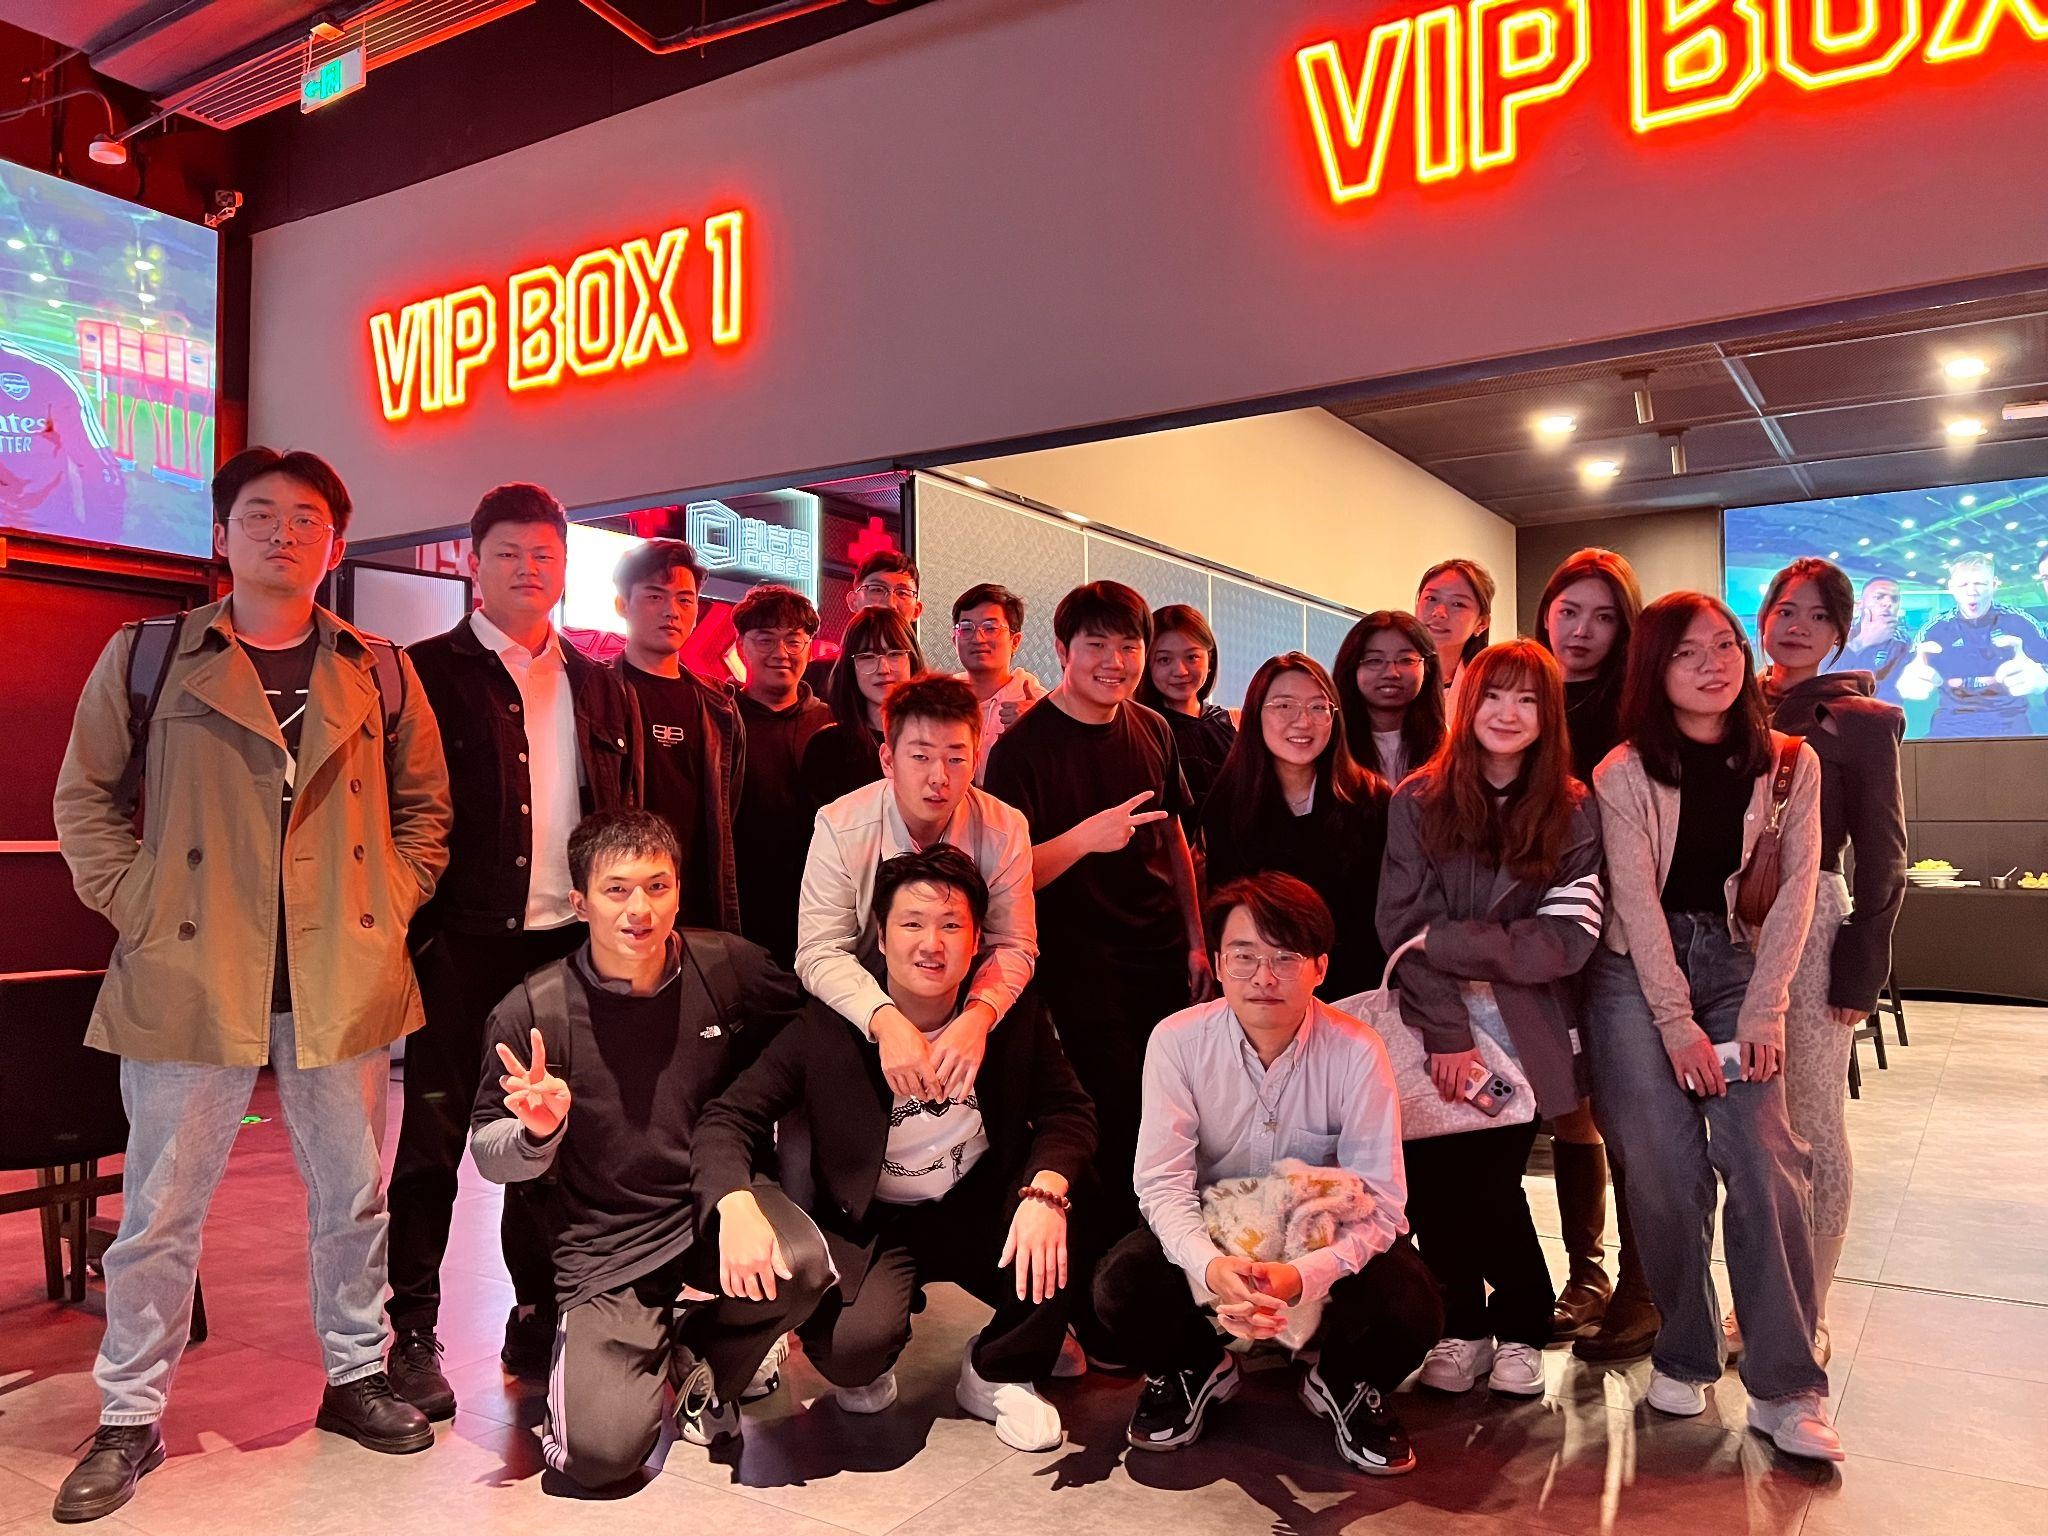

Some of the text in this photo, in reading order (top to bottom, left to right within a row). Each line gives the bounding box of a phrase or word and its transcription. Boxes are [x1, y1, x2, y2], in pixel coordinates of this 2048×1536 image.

[1296, 0, 1591, 204] VIP
[369, 210, 743, 421] VIP BOX 1
[743, 548, 811, 579] CAGES
